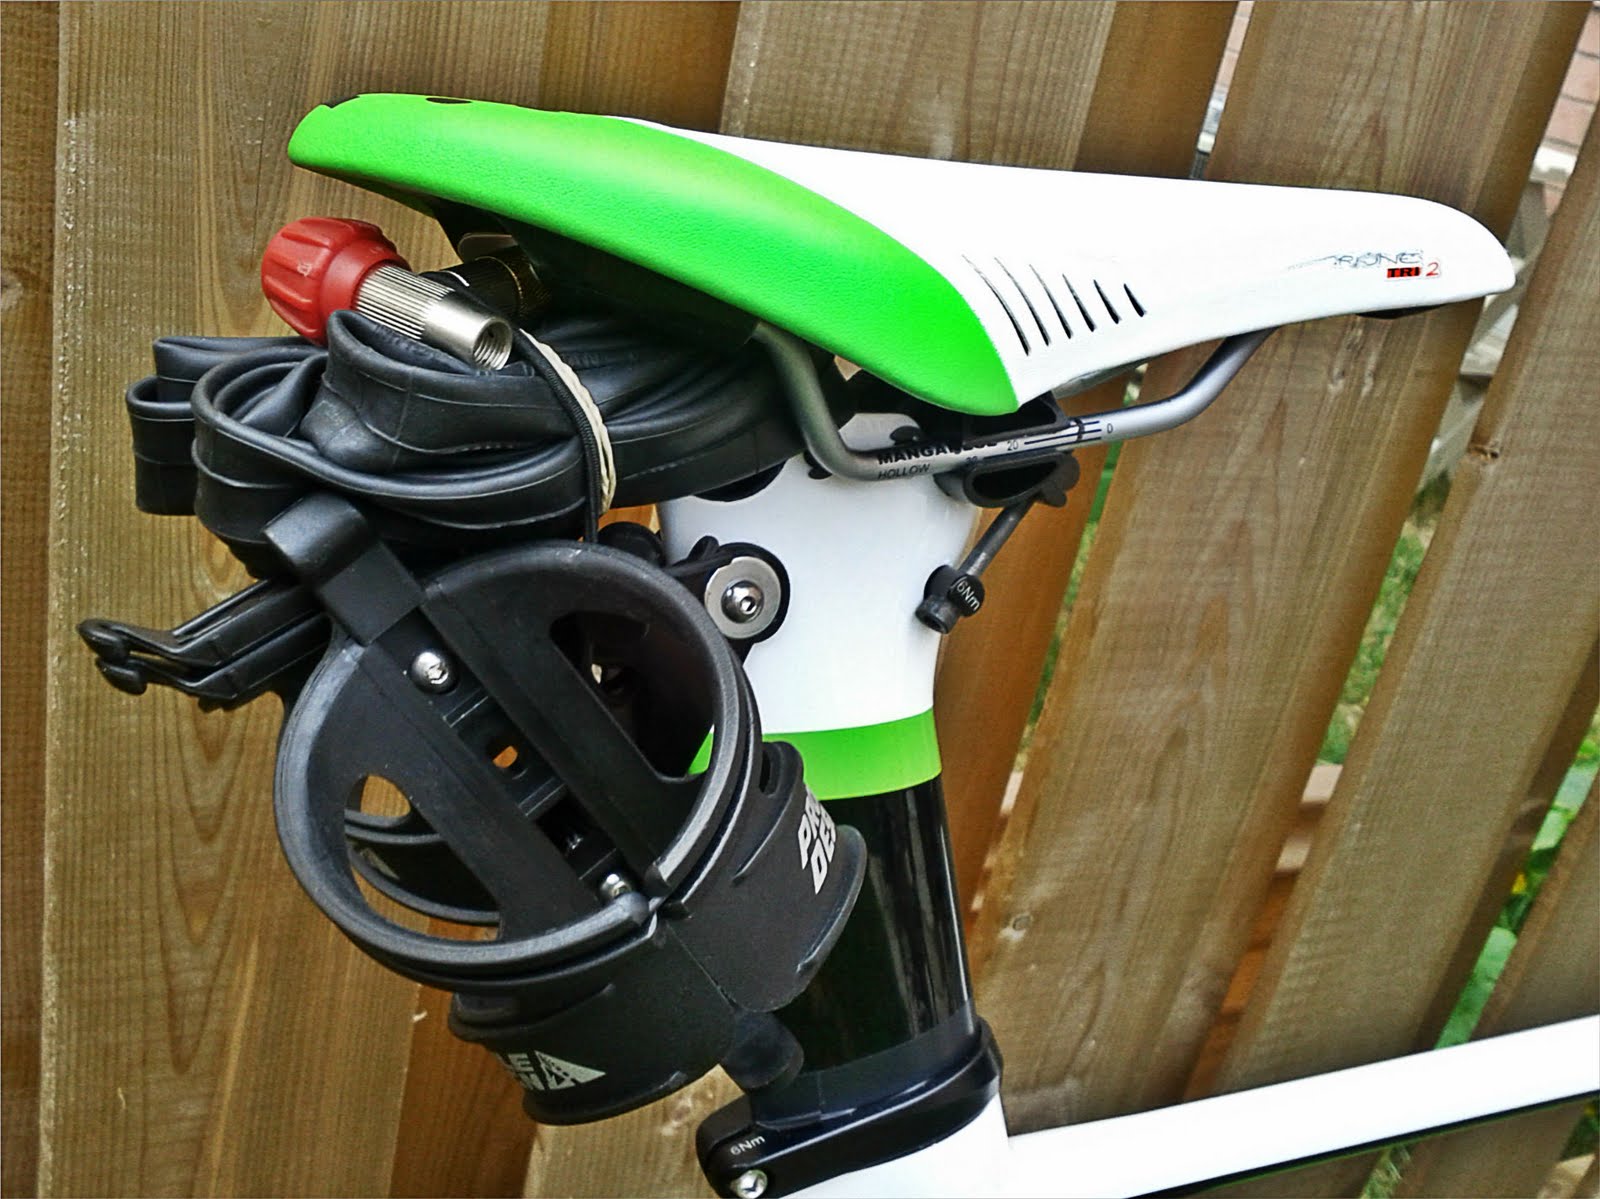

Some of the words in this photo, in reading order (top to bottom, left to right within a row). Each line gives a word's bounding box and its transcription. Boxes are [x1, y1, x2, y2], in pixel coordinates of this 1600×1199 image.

[1387, 266, 1421, 279] TRI
[1425, 261, 1439, 277] 2
[1106, 422, 1114, 434] 0
[877, 441, 998, 465] MANGA
[1006, 440, 1020, 452] 20
[878, 463, 931, 479] HOLLOW
[956, 580, 981, 611] 6Nm
[730, 1135, 766, 1156] 6Nm
